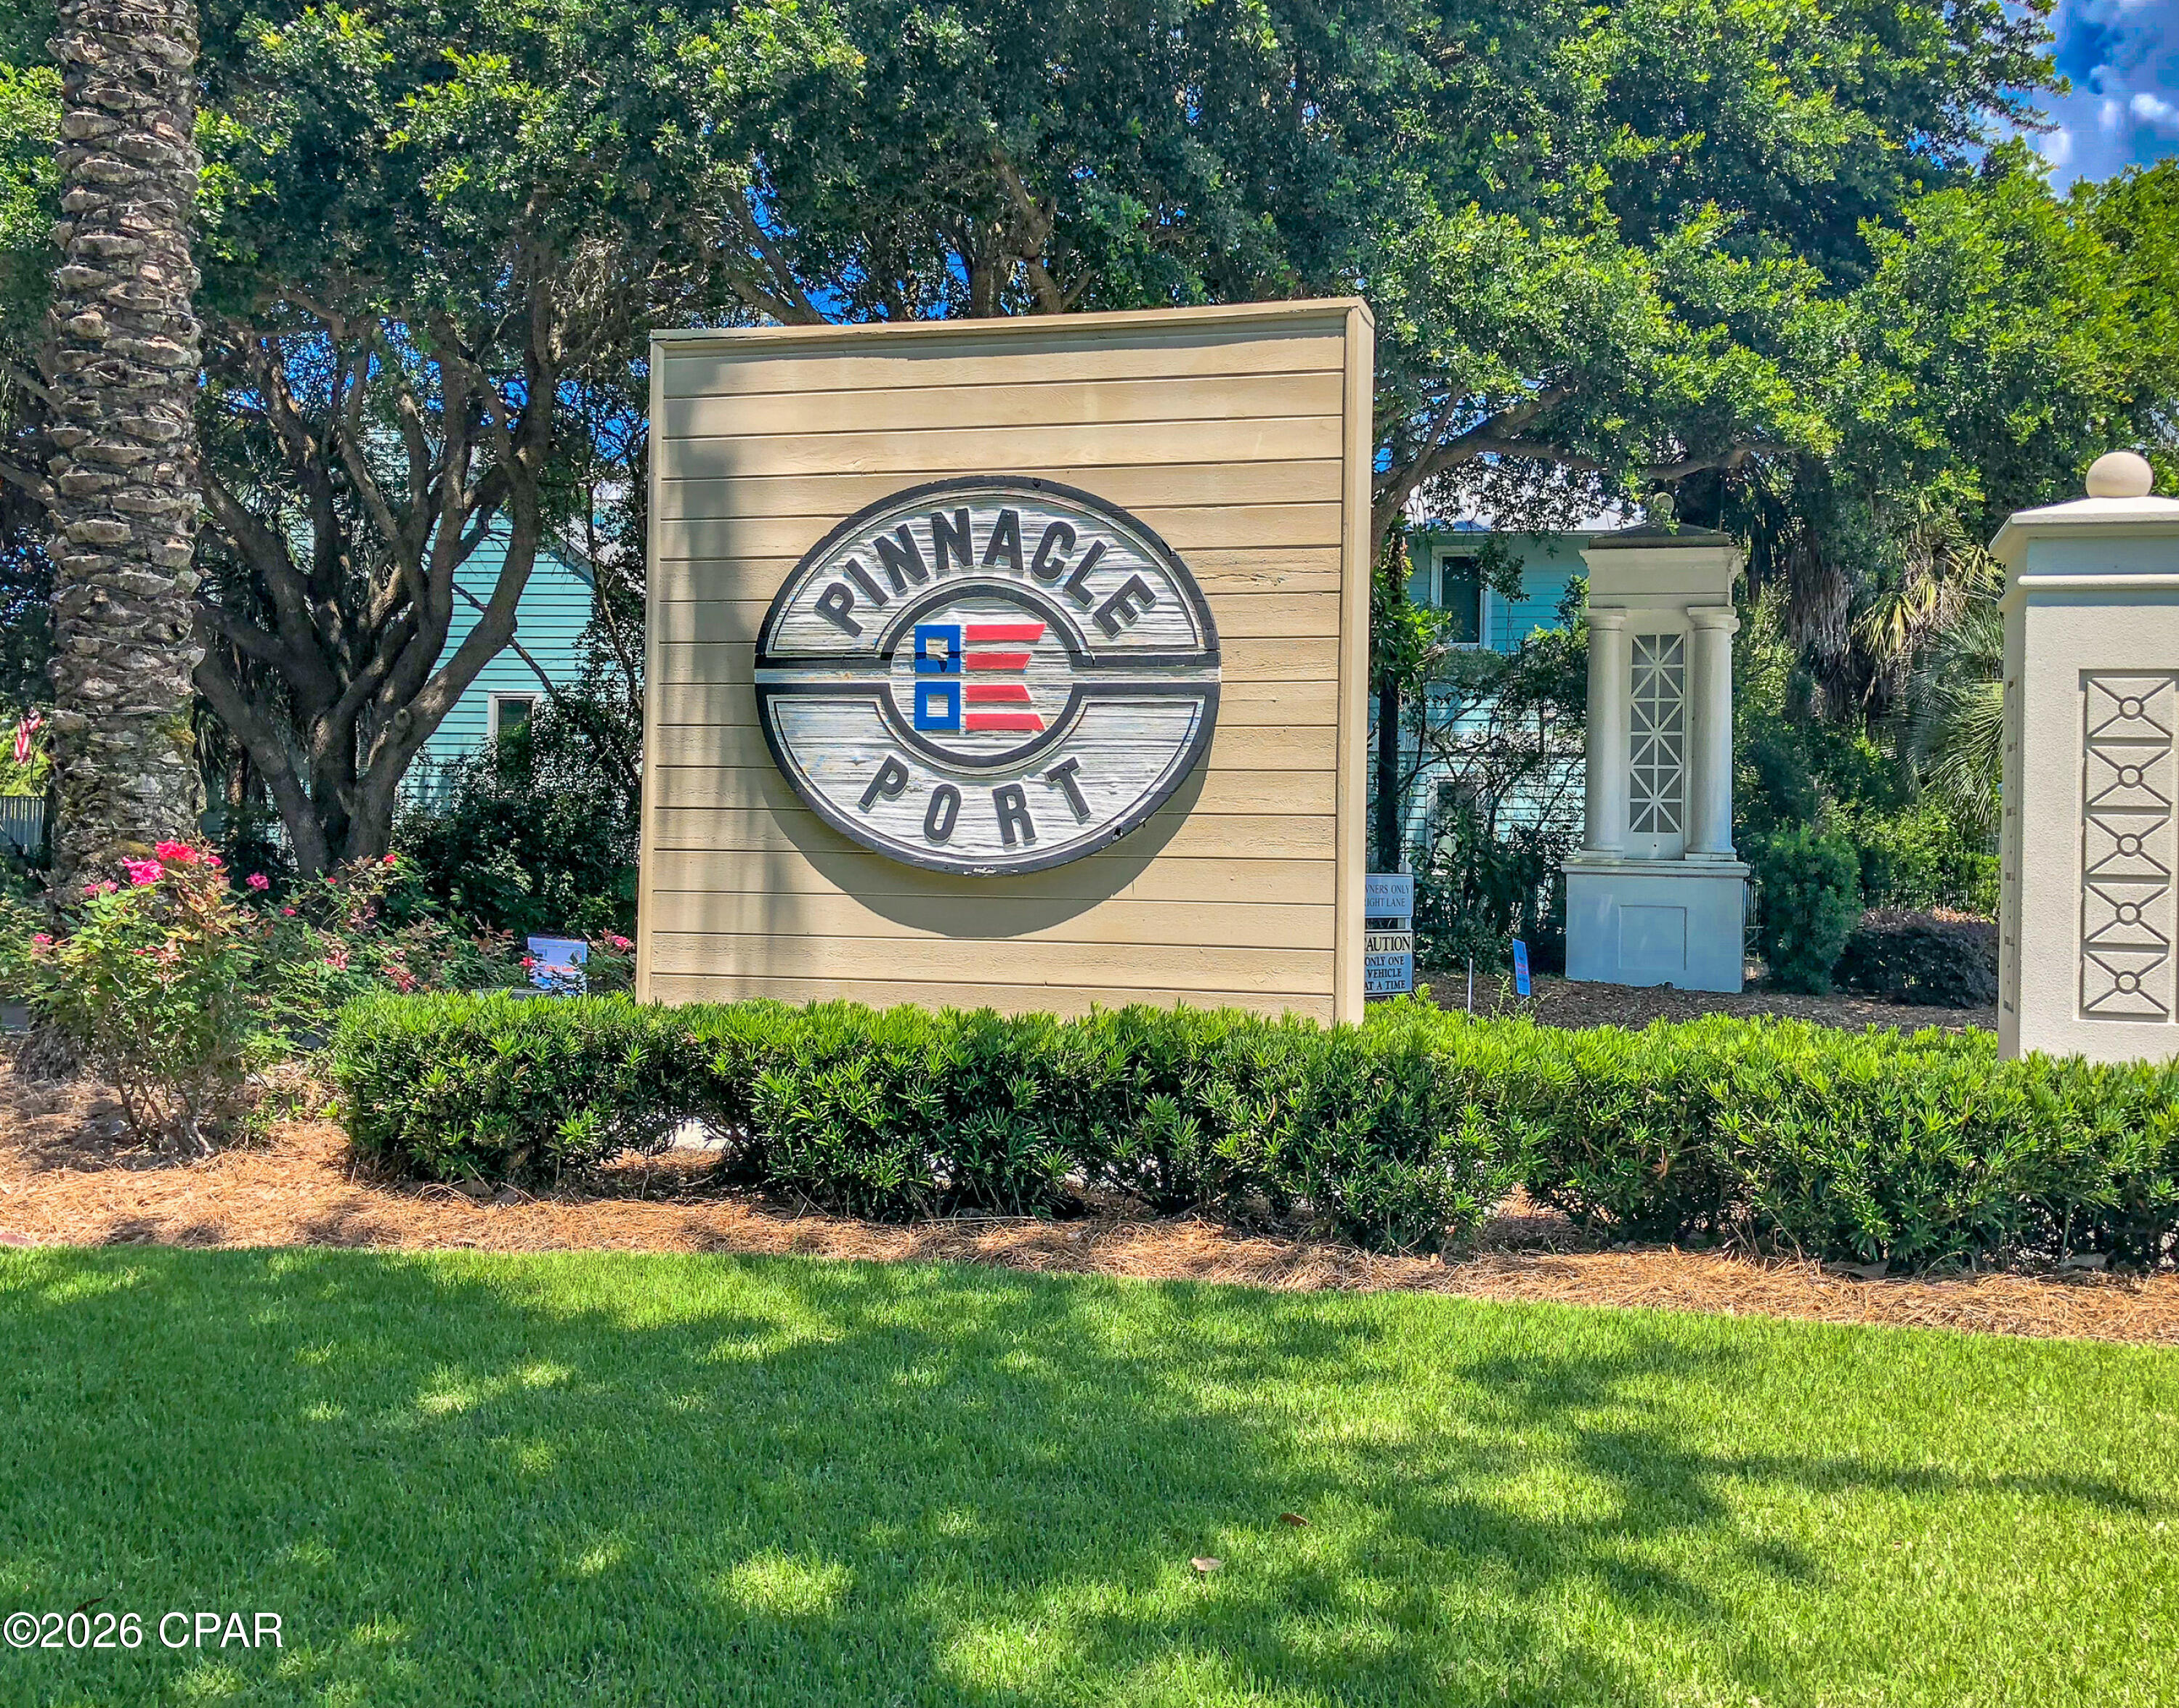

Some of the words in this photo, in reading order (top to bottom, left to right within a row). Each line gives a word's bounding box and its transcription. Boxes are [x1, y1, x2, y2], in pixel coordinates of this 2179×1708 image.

[814, 508, 1156, 638] PINNACLE
[858, 755, 1090, 847] PORT
[1366, 884, 1388, 894] NERS
[1391, 884, 1411, 894] ONLY
[1387, 898, 1405, 907] LANE
[1365, 936, 1411, 951] AUTION
[1365, 956, 1385, 967] ONLY
[1388, 956, 1405, 965] ONE
[1367, 968, 1402, 978] VEHICLE
[1365, 981, 1373, 991] AT
[1377, 981, 1382, 991] A
[1385, 980, 1405, 990] TIME
